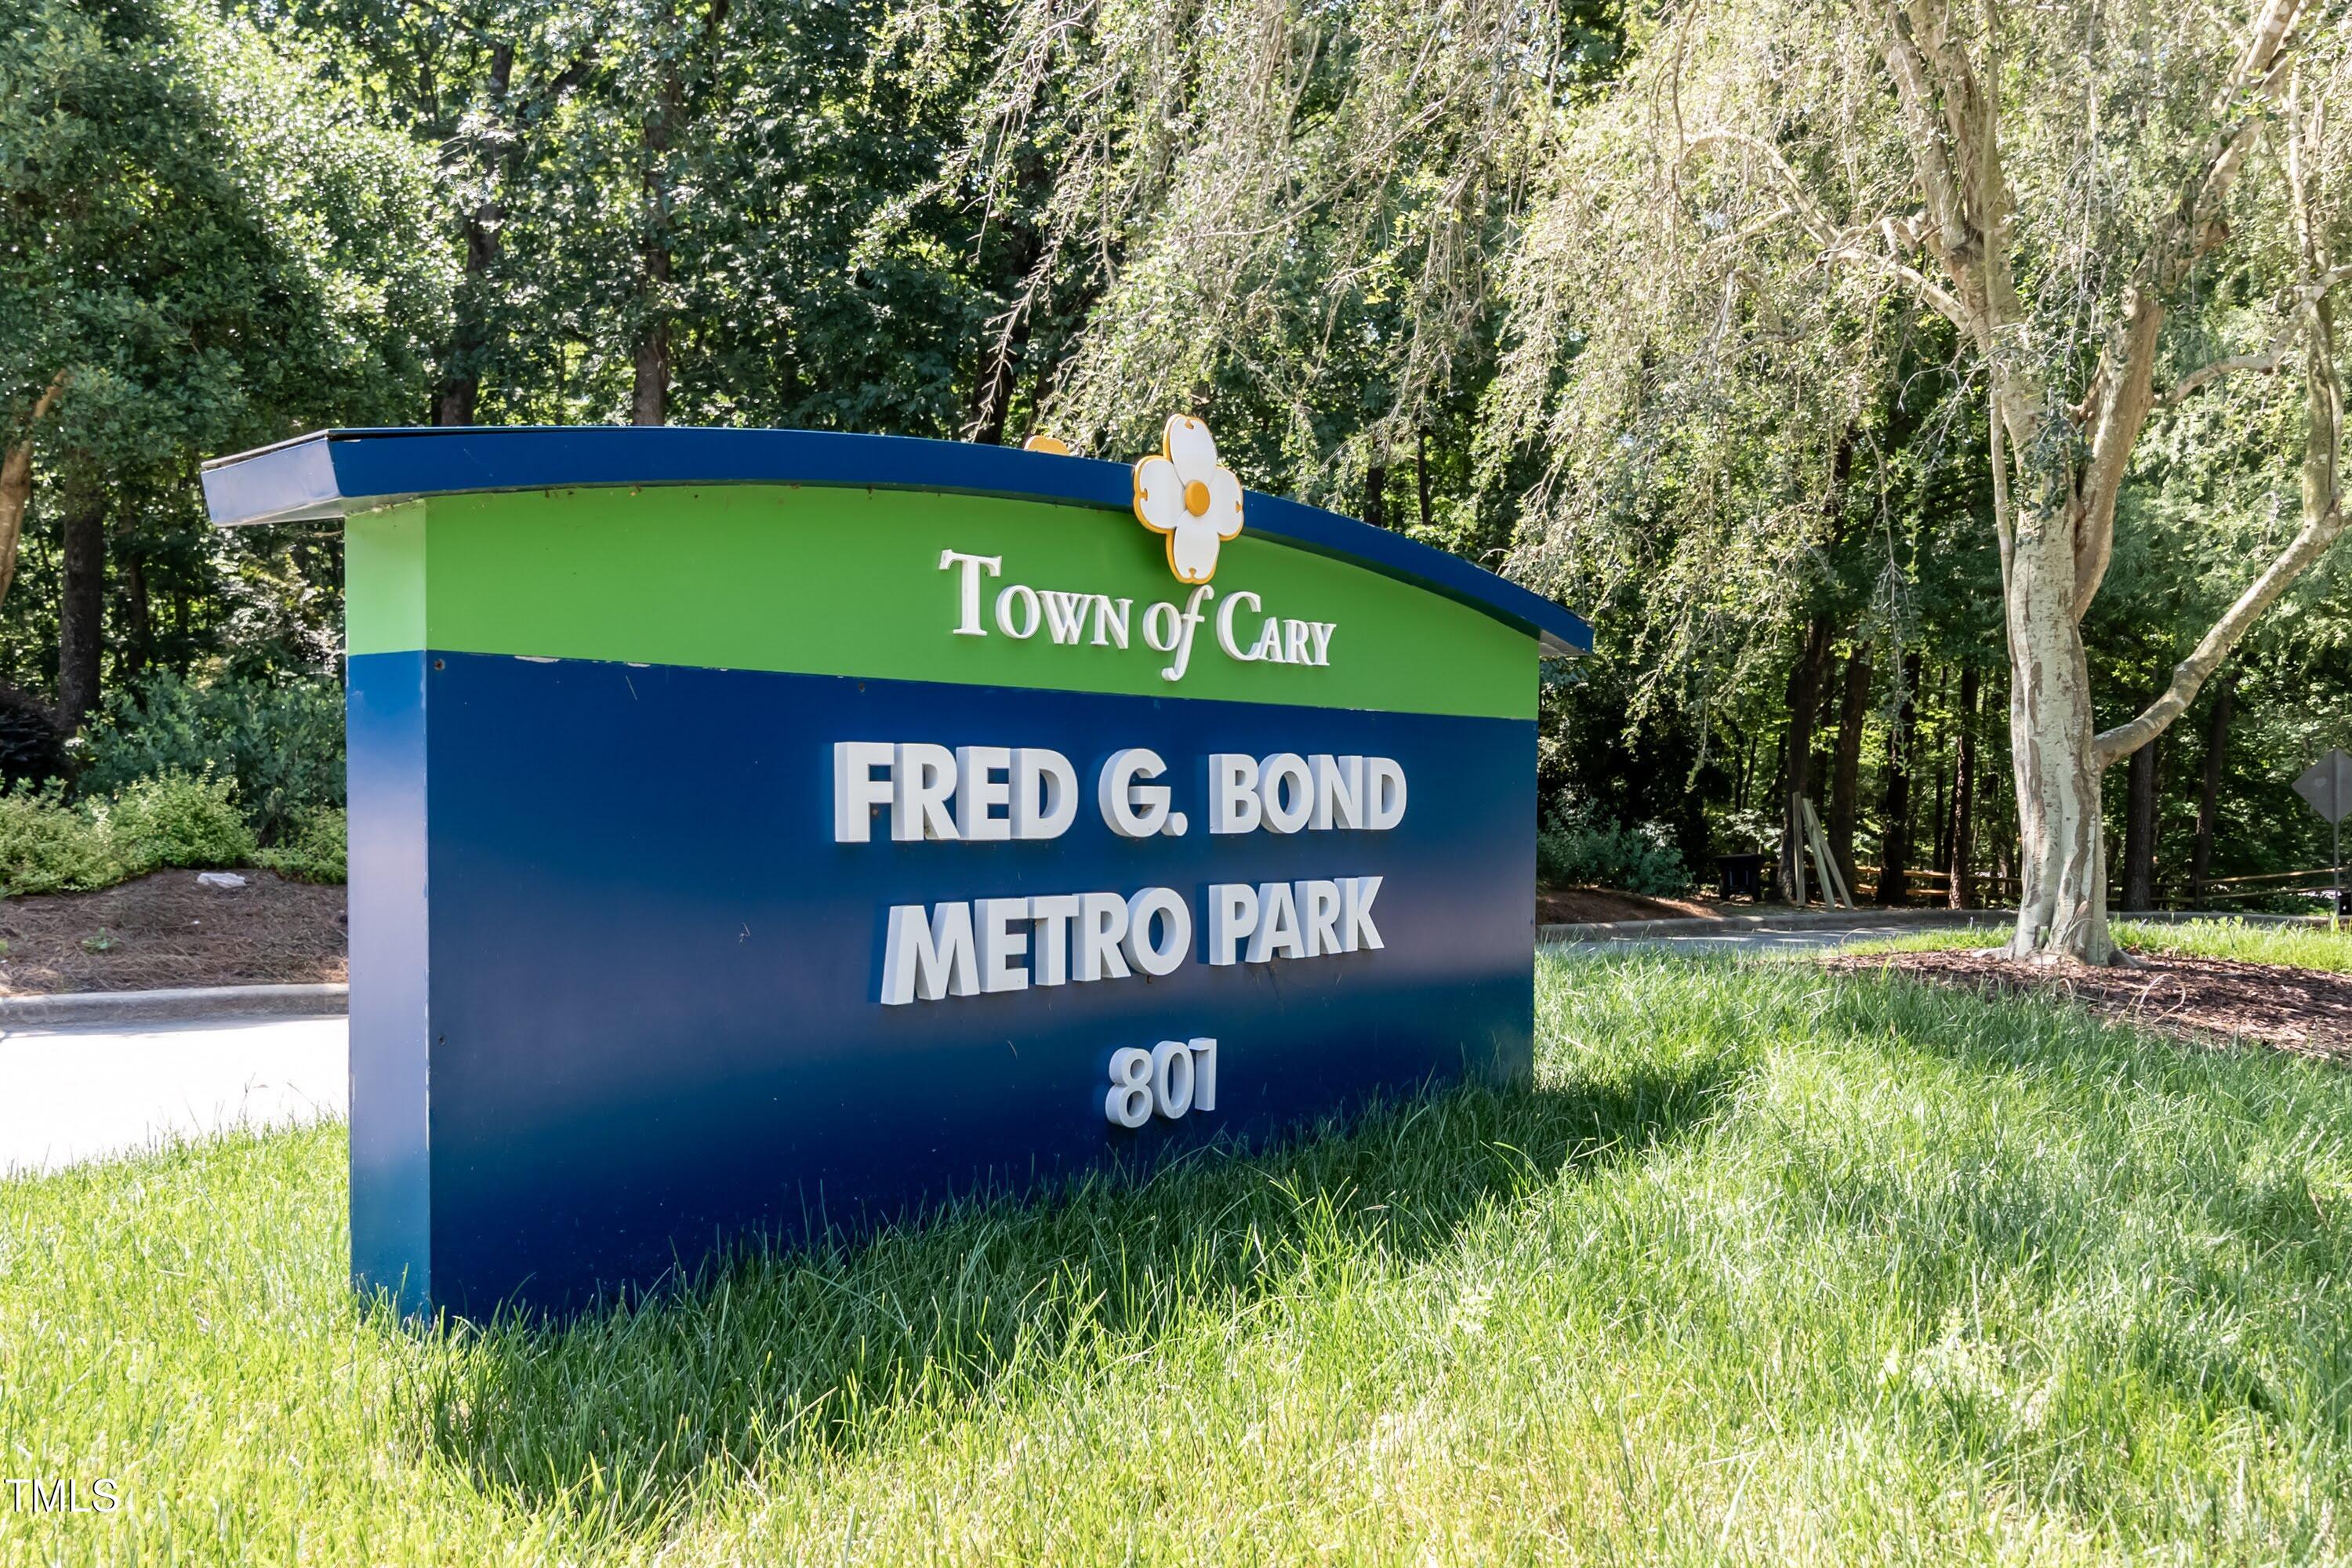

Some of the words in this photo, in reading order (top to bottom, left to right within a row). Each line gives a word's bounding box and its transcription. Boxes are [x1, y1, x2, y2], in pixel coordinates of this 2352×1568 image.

[1142, 584, 1214, 681] of
[834, 742, 1078, 843] FRED
[1098, 748, 1188, 837] G.
[1209, 753, 1407, 834] BOND
[880, 887, 1191, 1006] METRO
[1208, 876, 1385, 966] PARK
[1105, 1037, 1217, 1128] 801
